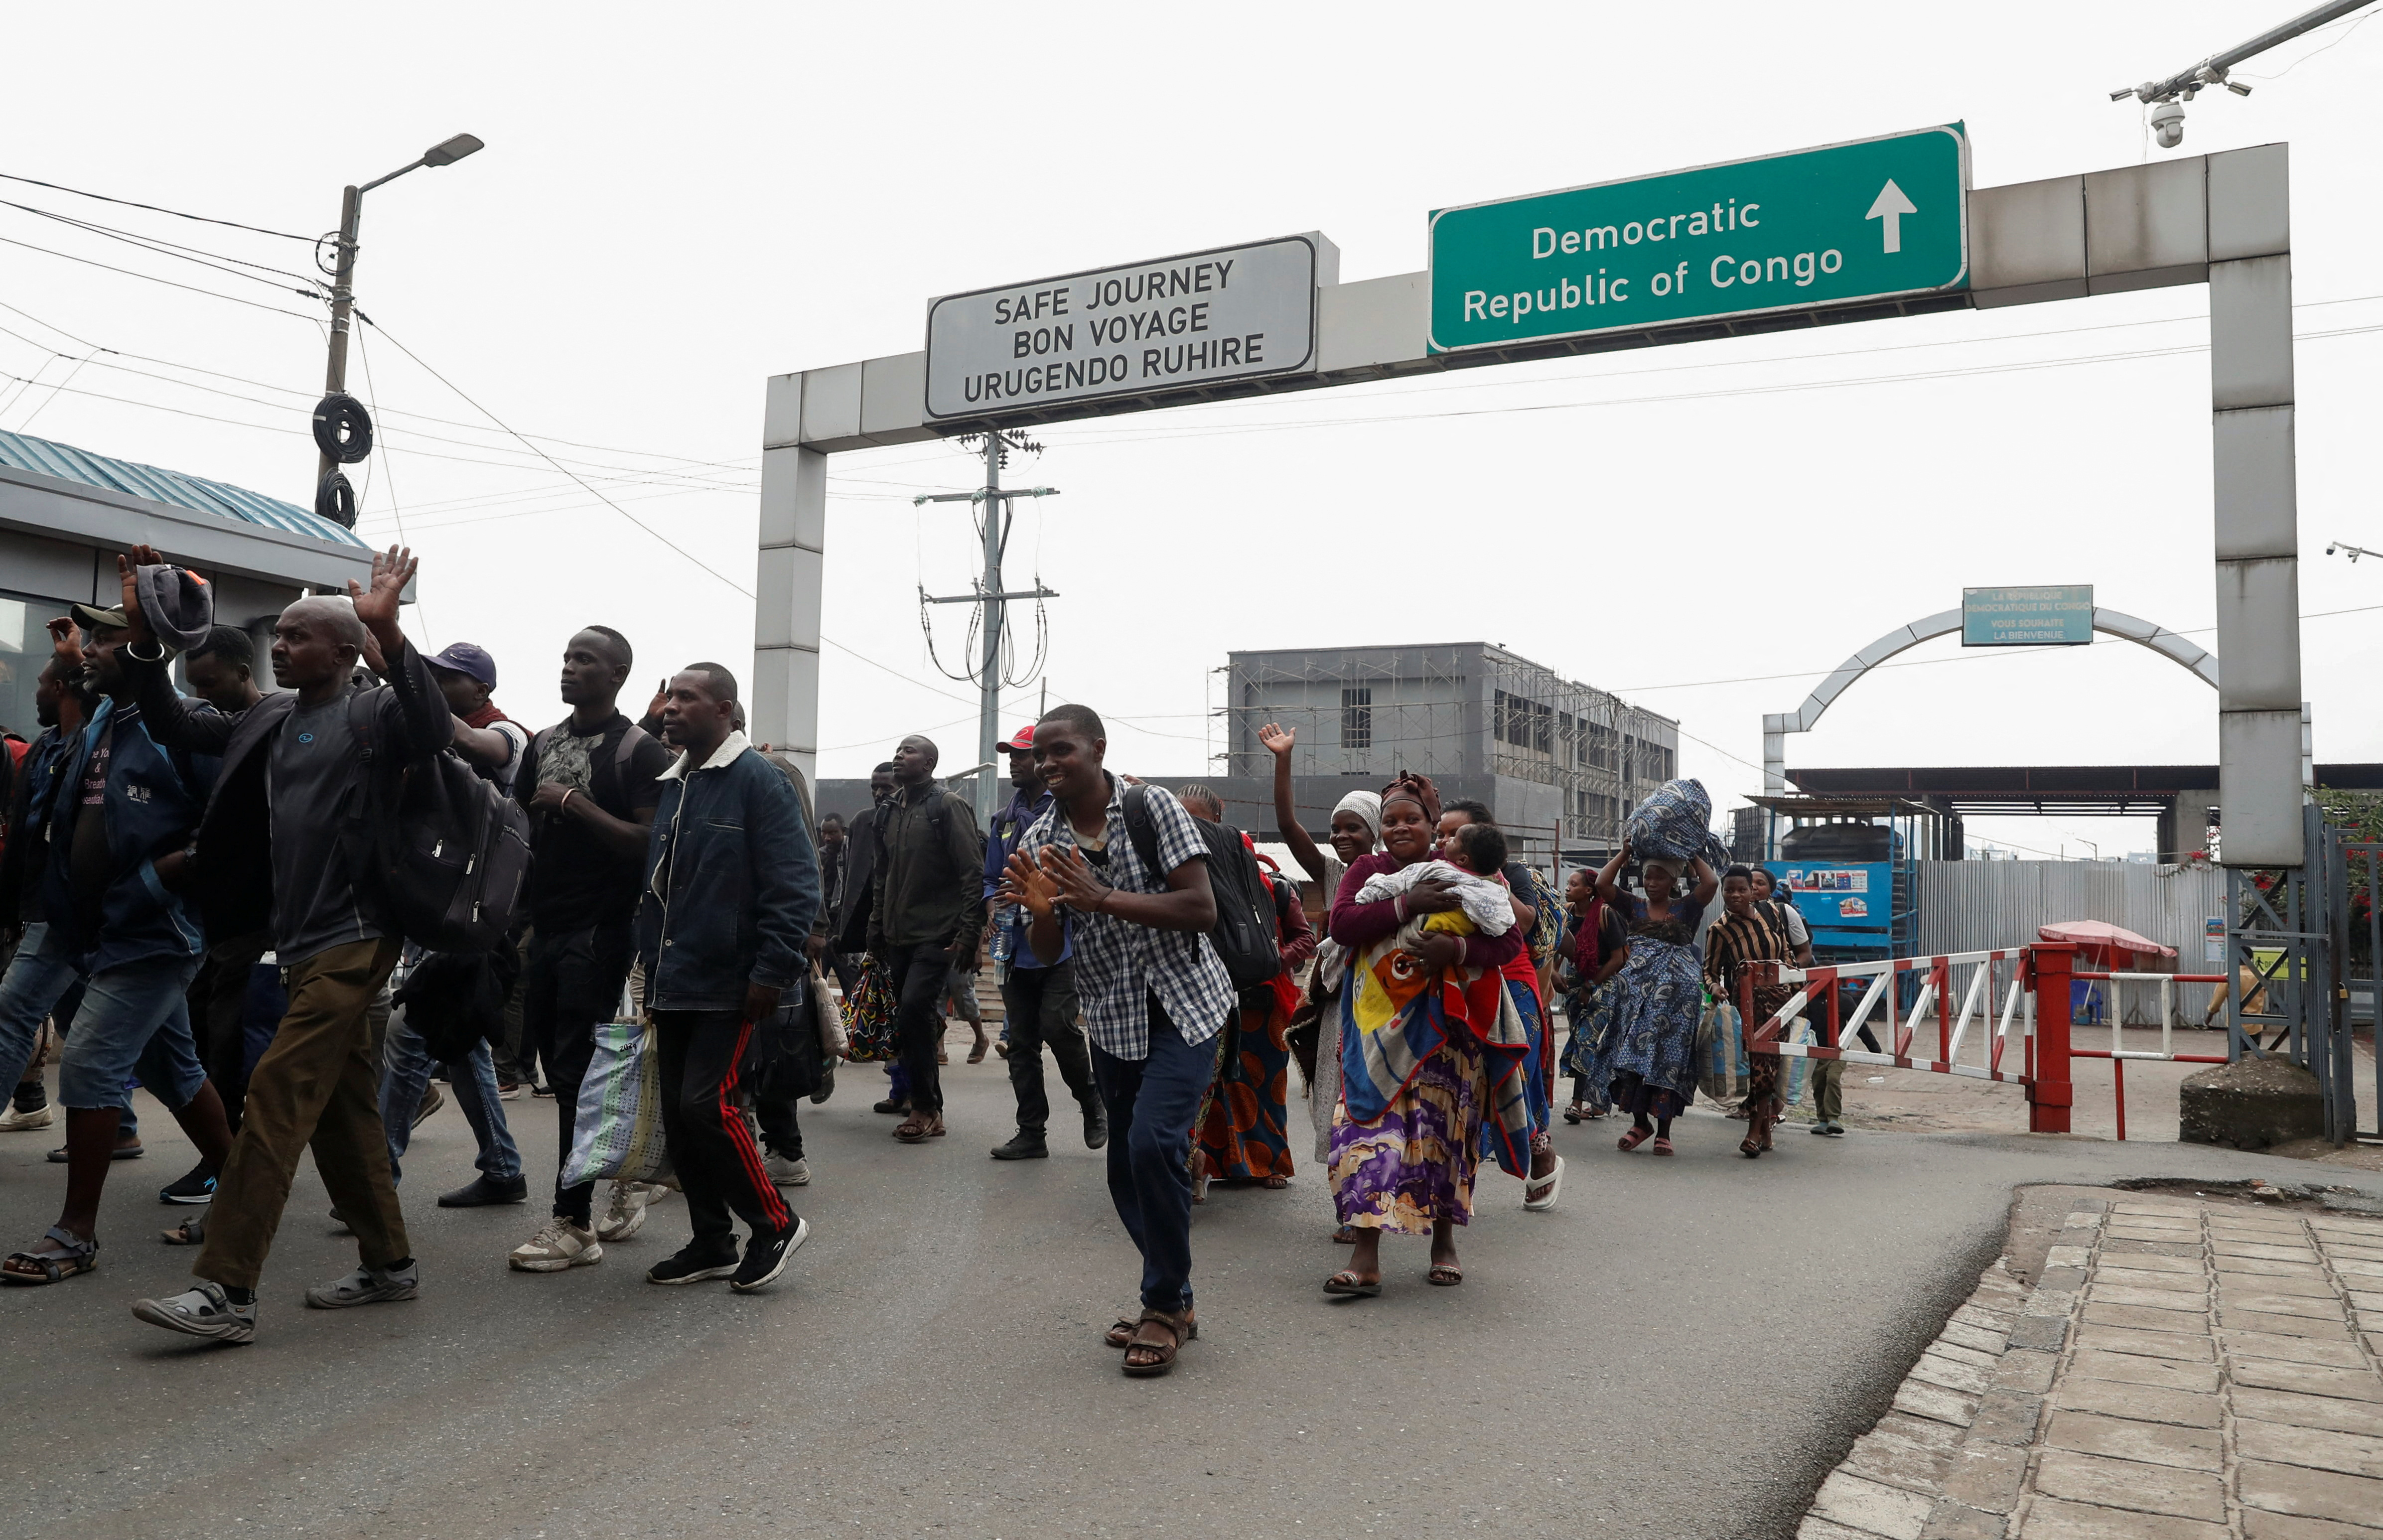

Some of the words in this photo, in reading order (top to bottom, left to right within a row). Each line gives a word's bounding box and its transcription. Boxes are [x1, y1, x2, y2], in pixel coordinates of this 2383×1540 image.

[1533, 198, 1760, 259] Democratic
[994, 287, 1070, 325] SAFE
[1086, 259, 1235, 310] JOURNEY
[1464, 268, 1629, 324] Republic
[1651, 261, 1688, 296] of
[1710, 249, 1842, 288] Congo
[1013, 323, 1074, 359] BON
[1089, 302, 1209, 347] VOYAGE
[965, 354, 1128, 403] URUGENDO
[1142, 333, 1264, 378] RUHIRE
[1991, 619, 2016, 628] VOUS
[2018, 618, 2065, 627] SOUHAITE
[2039, 602, 2052, 611] DU
[1994, 631, 2007, 640] LA
[95, 762, 101, 773] &
